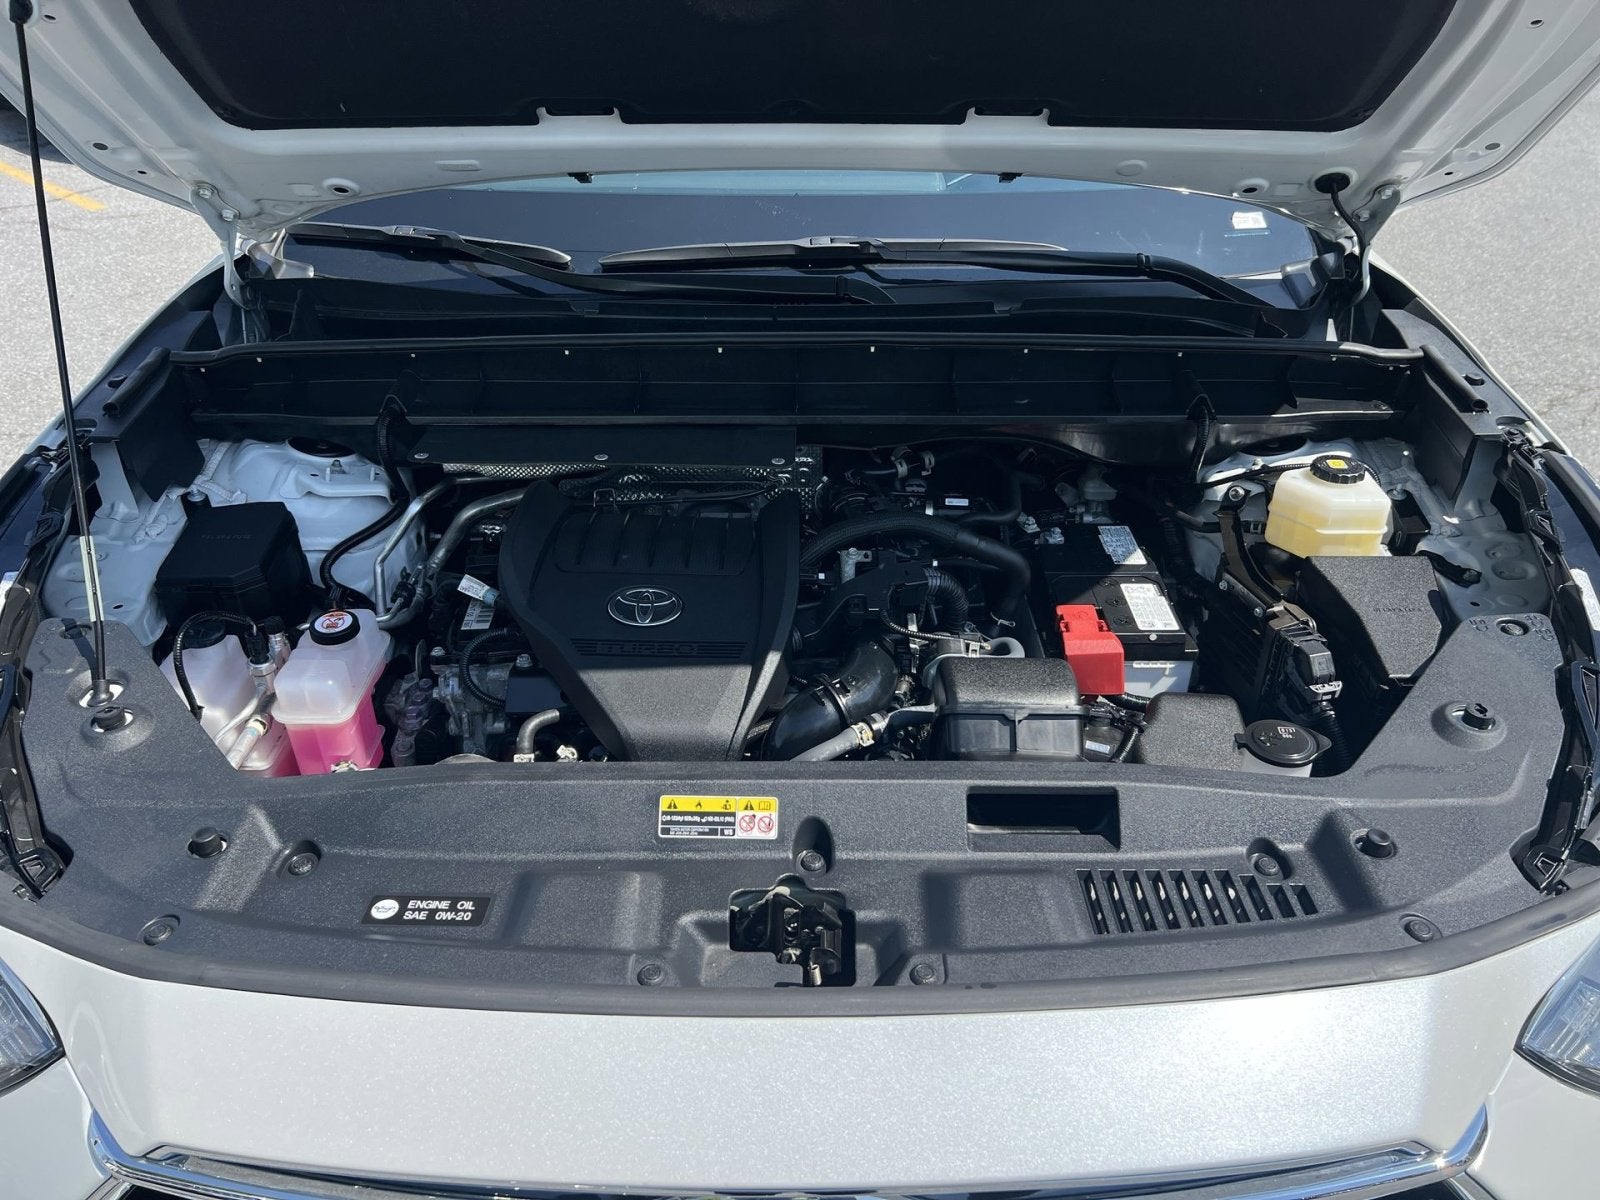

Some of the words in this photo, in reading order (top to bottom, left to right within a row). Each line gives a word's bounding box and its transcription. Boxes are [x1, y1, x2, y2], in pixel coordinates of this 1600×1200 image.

[407, 900, 451, 909] ENGINE
[456, 901, 476, 910] OIL
[403, 911, 428, 920] SAE
[435, 911, 472, 921] 0W-20
